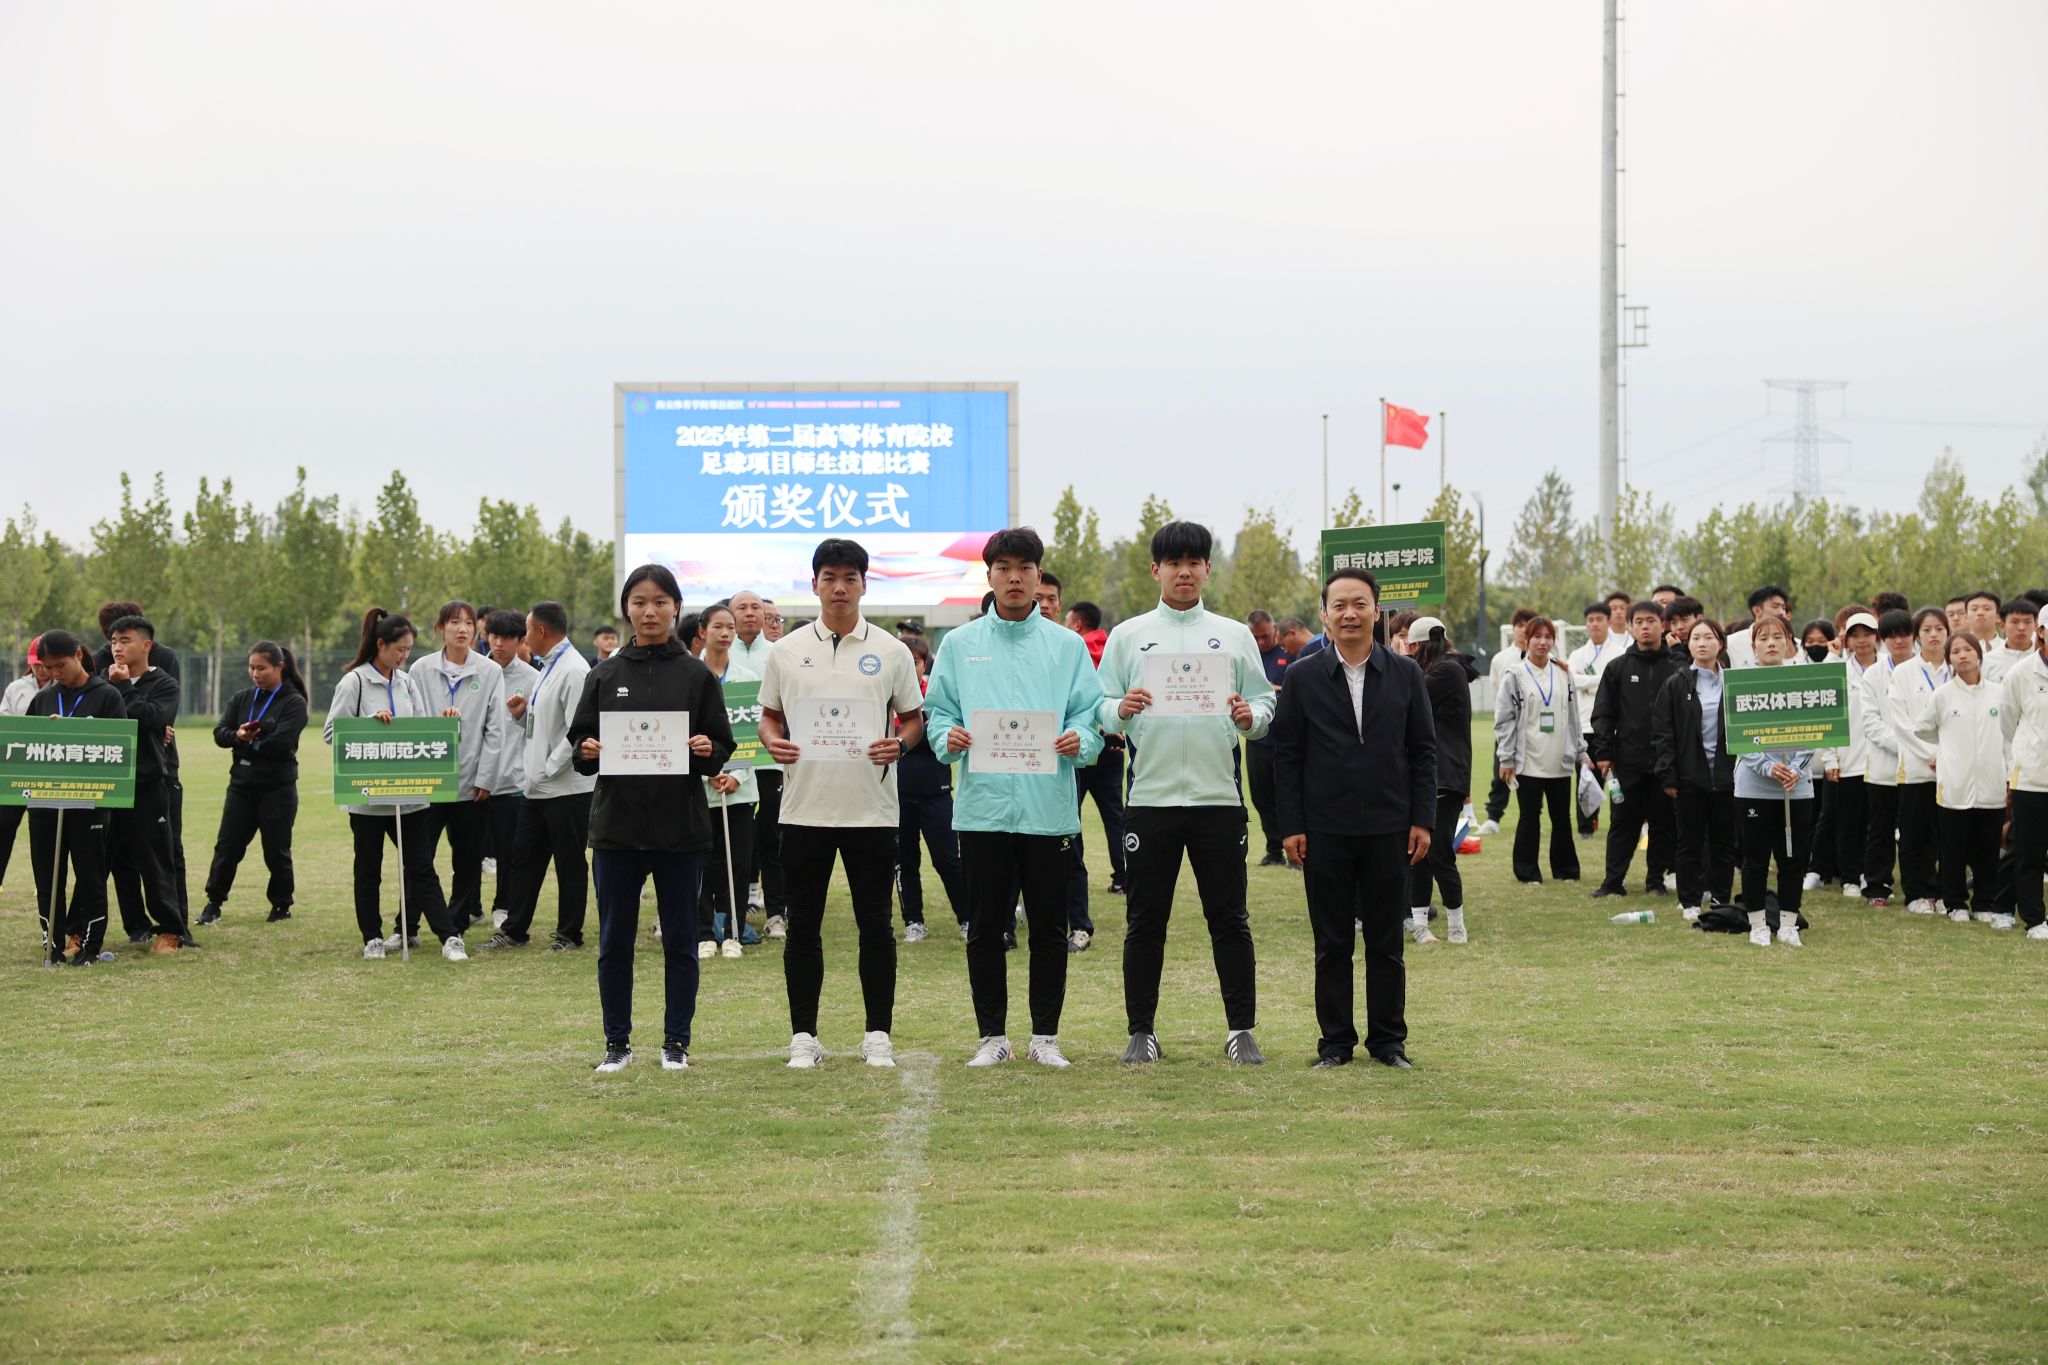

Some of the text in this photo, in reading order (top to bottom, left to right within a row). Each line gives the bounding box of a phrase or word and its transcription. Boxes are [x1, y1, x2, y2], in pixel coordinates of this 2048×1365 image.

[676, 423, 954, 449] 2025年第二届高等体育院校
[700, 450, 931, 476] 足球项目师生技能比赛
[720, 482, 911, 529] 颁奖仪式
[1333, 547, 1435, 571] 南京体育学院
[1736, 689, 1837, 712] 武汉体育学院
[5, 742, 123, 763] 广州体育学院
[345, 741, 448, 760] 海南师范大学
[620, 753, 669, 762] 学生二等奖
